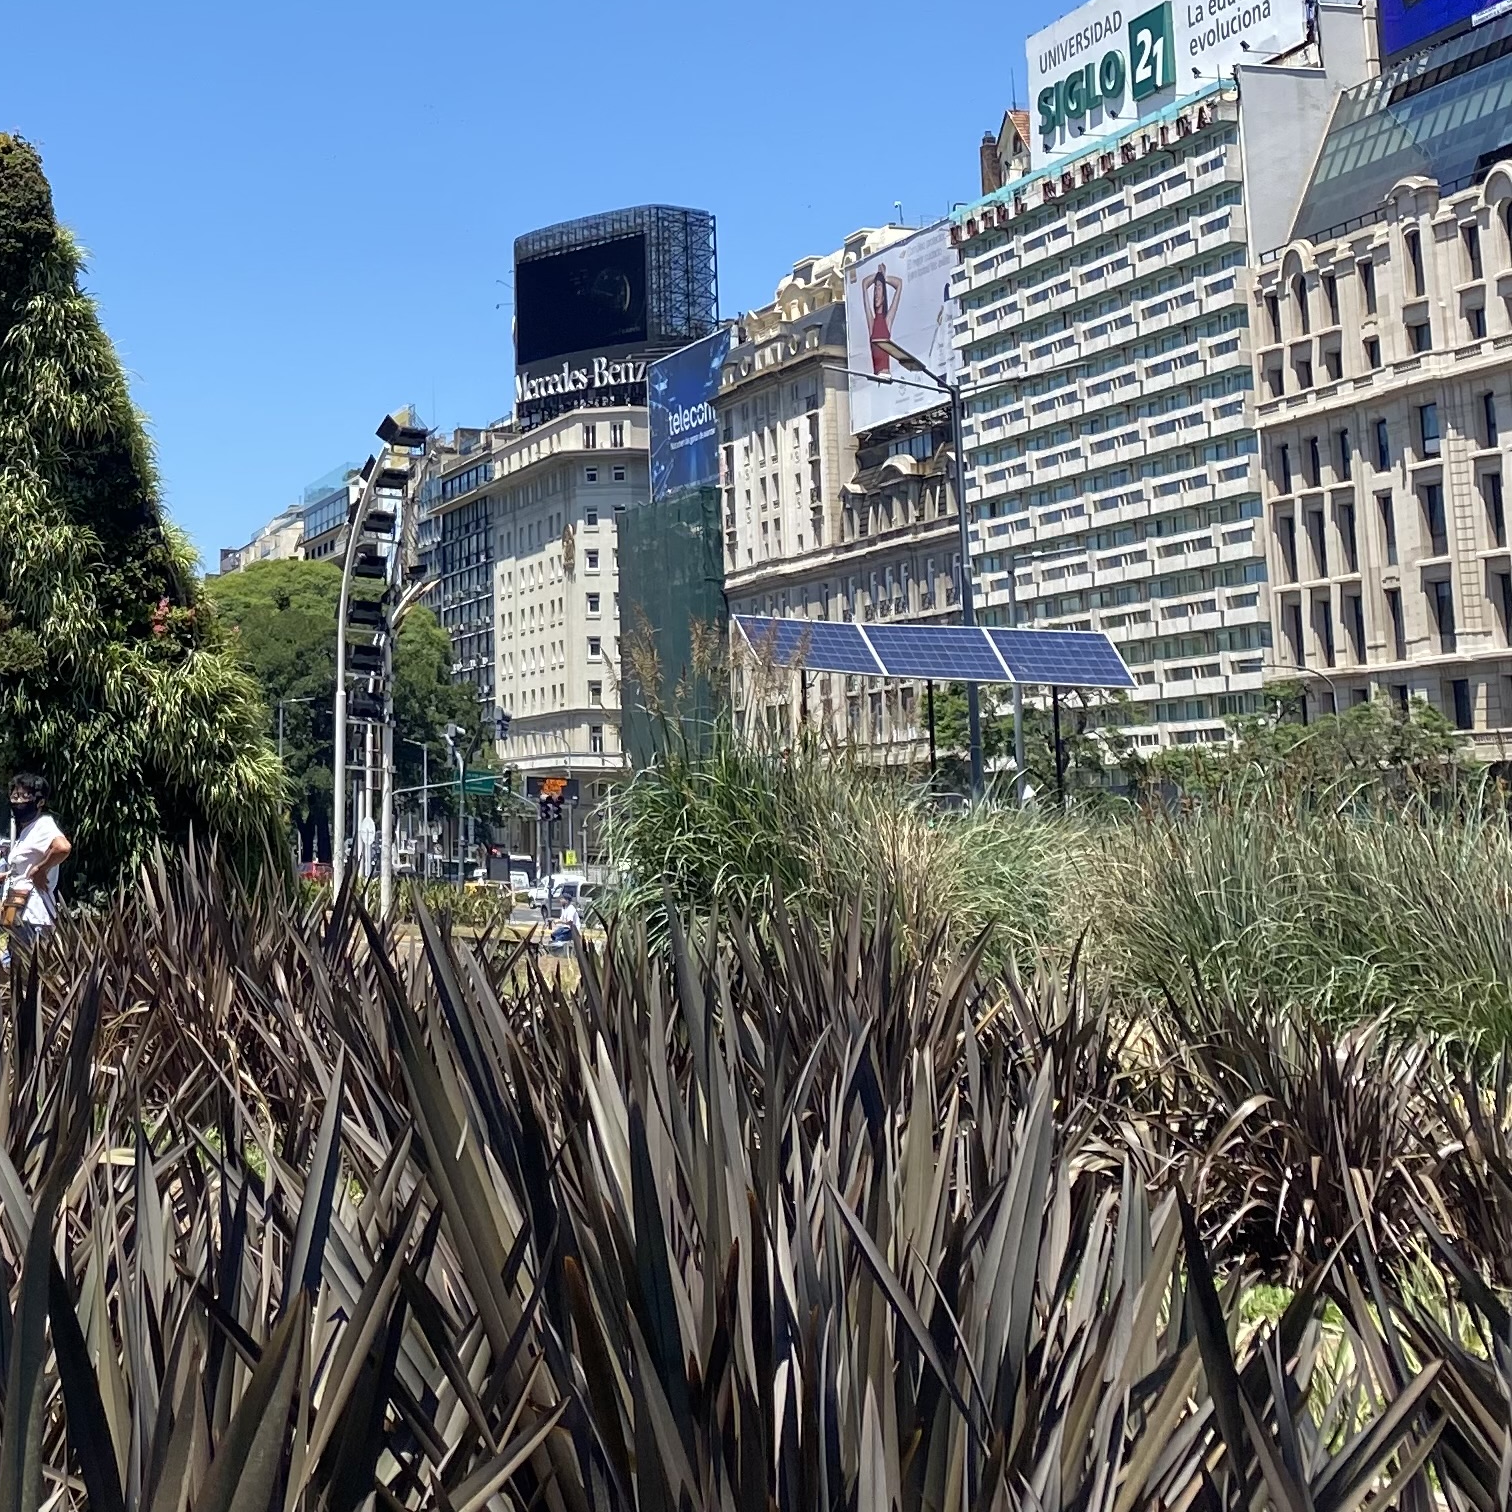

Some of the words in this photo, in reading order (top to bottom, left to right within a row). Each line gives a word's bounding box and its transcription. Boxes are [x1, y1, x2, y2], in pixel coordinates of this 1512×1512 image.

[1039, 10, 1123, 74] UNIVERSIDAD
[1187, 5, 1204, 28] La
[1189, 0, 1271, 56] evoluciona
[1038, 49, 1125, 134] SIGLO
[1135, 28, 1164, 87] 21
[515, 356, 648, 403] Mercedes-Benz
[669, 402, 716, 436] telecom
